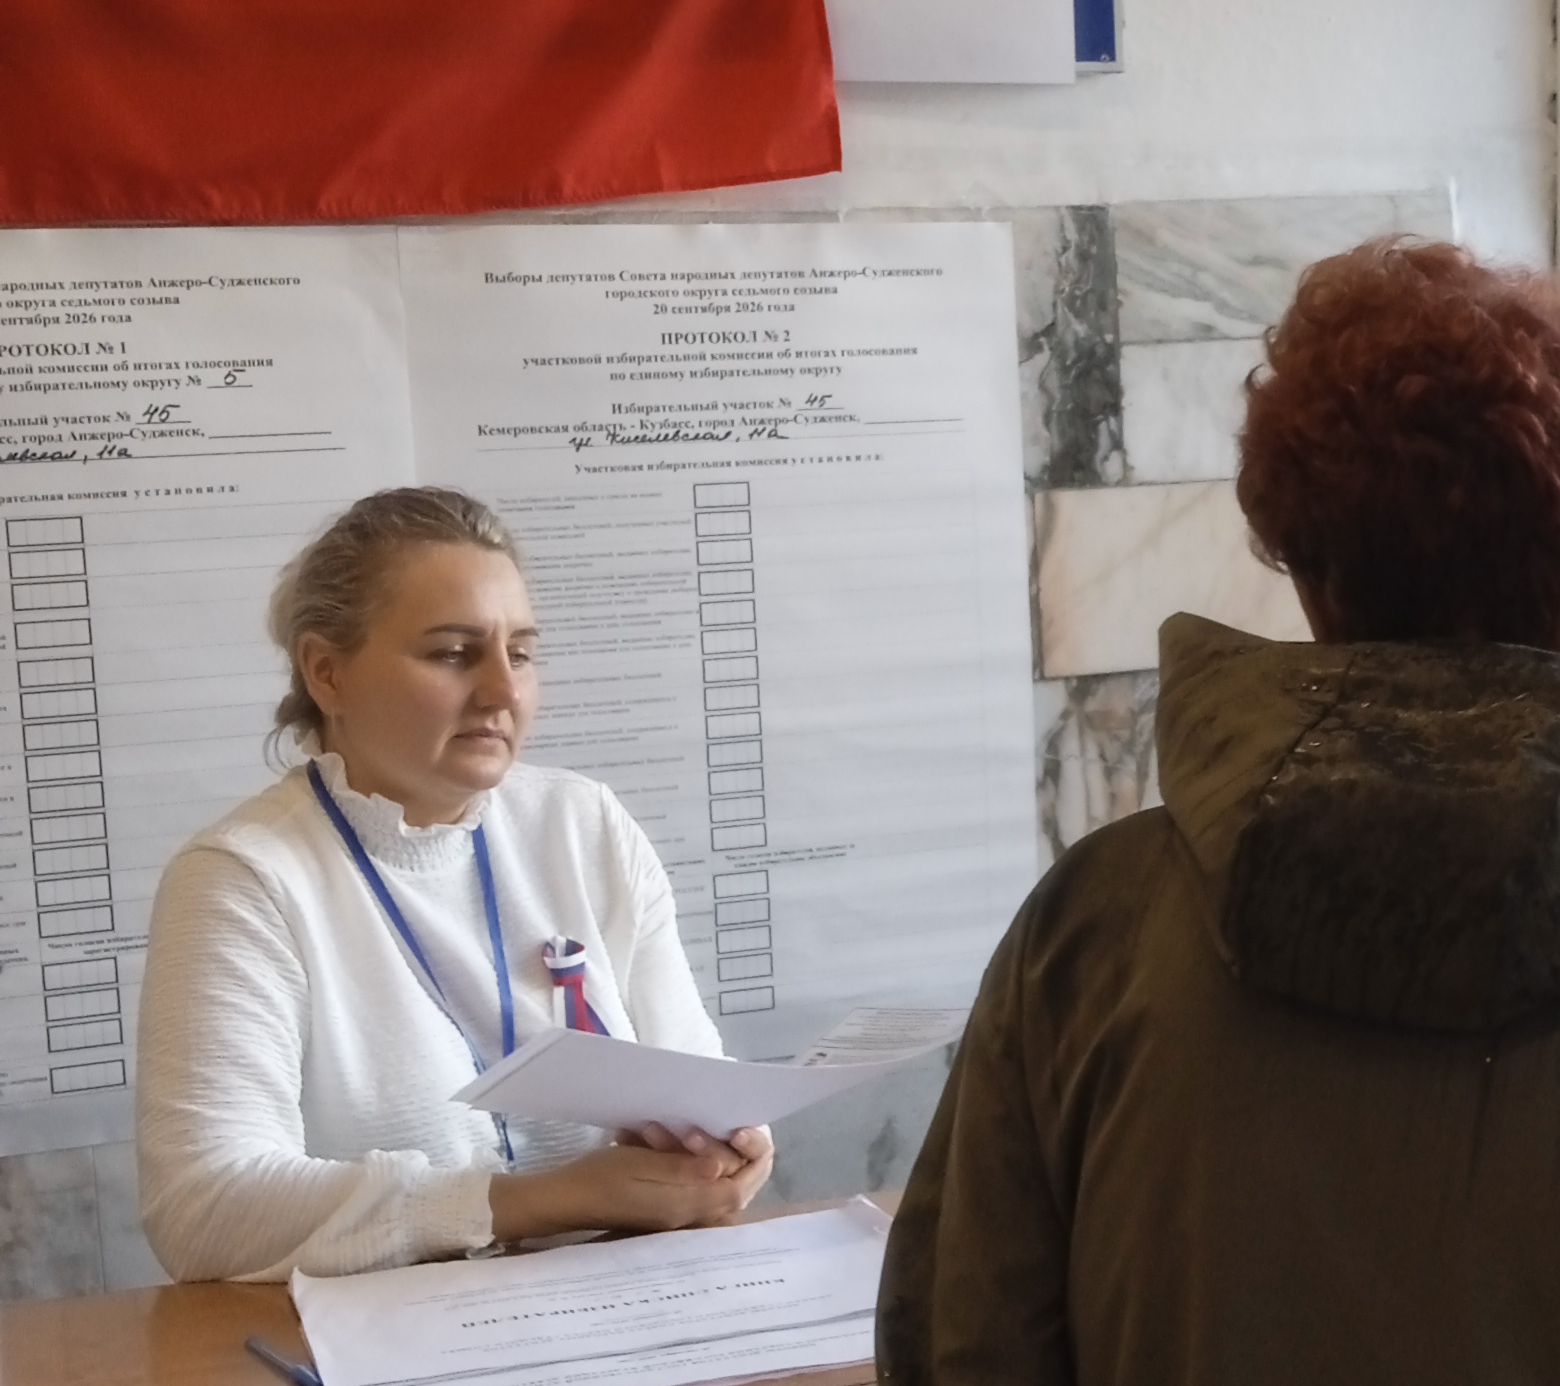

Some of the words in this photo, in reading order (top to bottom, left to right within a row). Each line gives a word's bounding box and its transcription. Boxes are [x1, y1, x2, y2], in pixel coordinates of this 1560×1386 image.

[0, 281, 65, 294] ародных
[69, 278, 143, 292] депутатов
[147, 274, 301, 290] Анжеро-Судженского
[484, 271, 543, 286] Выборы
[546, 271, 616, 285] депутатов
[619, 269, 667, 282] Совета
[670, 270, 736, 284] народных
[739, 269, 805, 283] депутатов
[809, 266, 943, 281] Анжеро-Судженского
[605, 287, 679, 301] городского
[683, 287, 728, 300] округа
[731, 286, 790, 297] седьмого
[794, 285, 839, 295] созыва
[6, 298, 56, 311] округа
[60, 296, 126, 308] седьмого
[130, 295, 181, 306] созыва
[652, 303, 668, 315] 20
[671, 302, 731, 317] сентября
[734, 302, 764, 314] 2026
[767, 302, 796, 313] года
[0, 313, 61, 327] ентября
[64, 312, 97, 324] 2026
[101, 314, 133, 324] года
[660, 330, 758, 345] ПРОТОКОЛ
[763, 330, 779, 343] №
[783, 330, 791, 342] 2
[0, 342, 90, 357] РОТОКОЛ
[96, 342, 114, 355] №
[120, 342, 127, 354] 1
[522, 353, 602, 368] участковой
[606, 351, 707, 365] избирательной
[710, 349, 775, 361] комиссии
[777, 347, 793, 359] об
[795, 348, 838, 359] итогах
[841, 345, 918, 358] голосования
[38, 364, 109, 375] комиссии
[113, 361, 129, 372] об
[133, 362, 181, 372] итогах
[185, 357, 274, 370] голосования
[610, 373, 627, 383] по
[630, 370, 686, 383] единому
[689, 366, 796, 381] избирательному
[799, 365, 842, 378] округу
[9, 379, 129, 394] избирательному
[133, 376, 181, 390] округу
[186, 375, 201, 386] №
[611, 400, 719, 415] Избирательный
[722, 400, 775, 413] участок
[778, 397, 792, 409] №
[53, 415, 111, 428] участок
[115, 411, 131, 422] №
[142, 404, 180, 425] 45
[477, 421, 569, 437] Кемеровская
[698, 417, 735, 431] город
[22, 434, 63, 447] город
[67, 427, 206, 444] Анжеро-Судженск,
[574, 463, 644, 476] Участковая
[647, 458, 733, 472] избирательная
[735, 456, 788, 468] комиссия
[67, 489, 127, 501] комиссия
